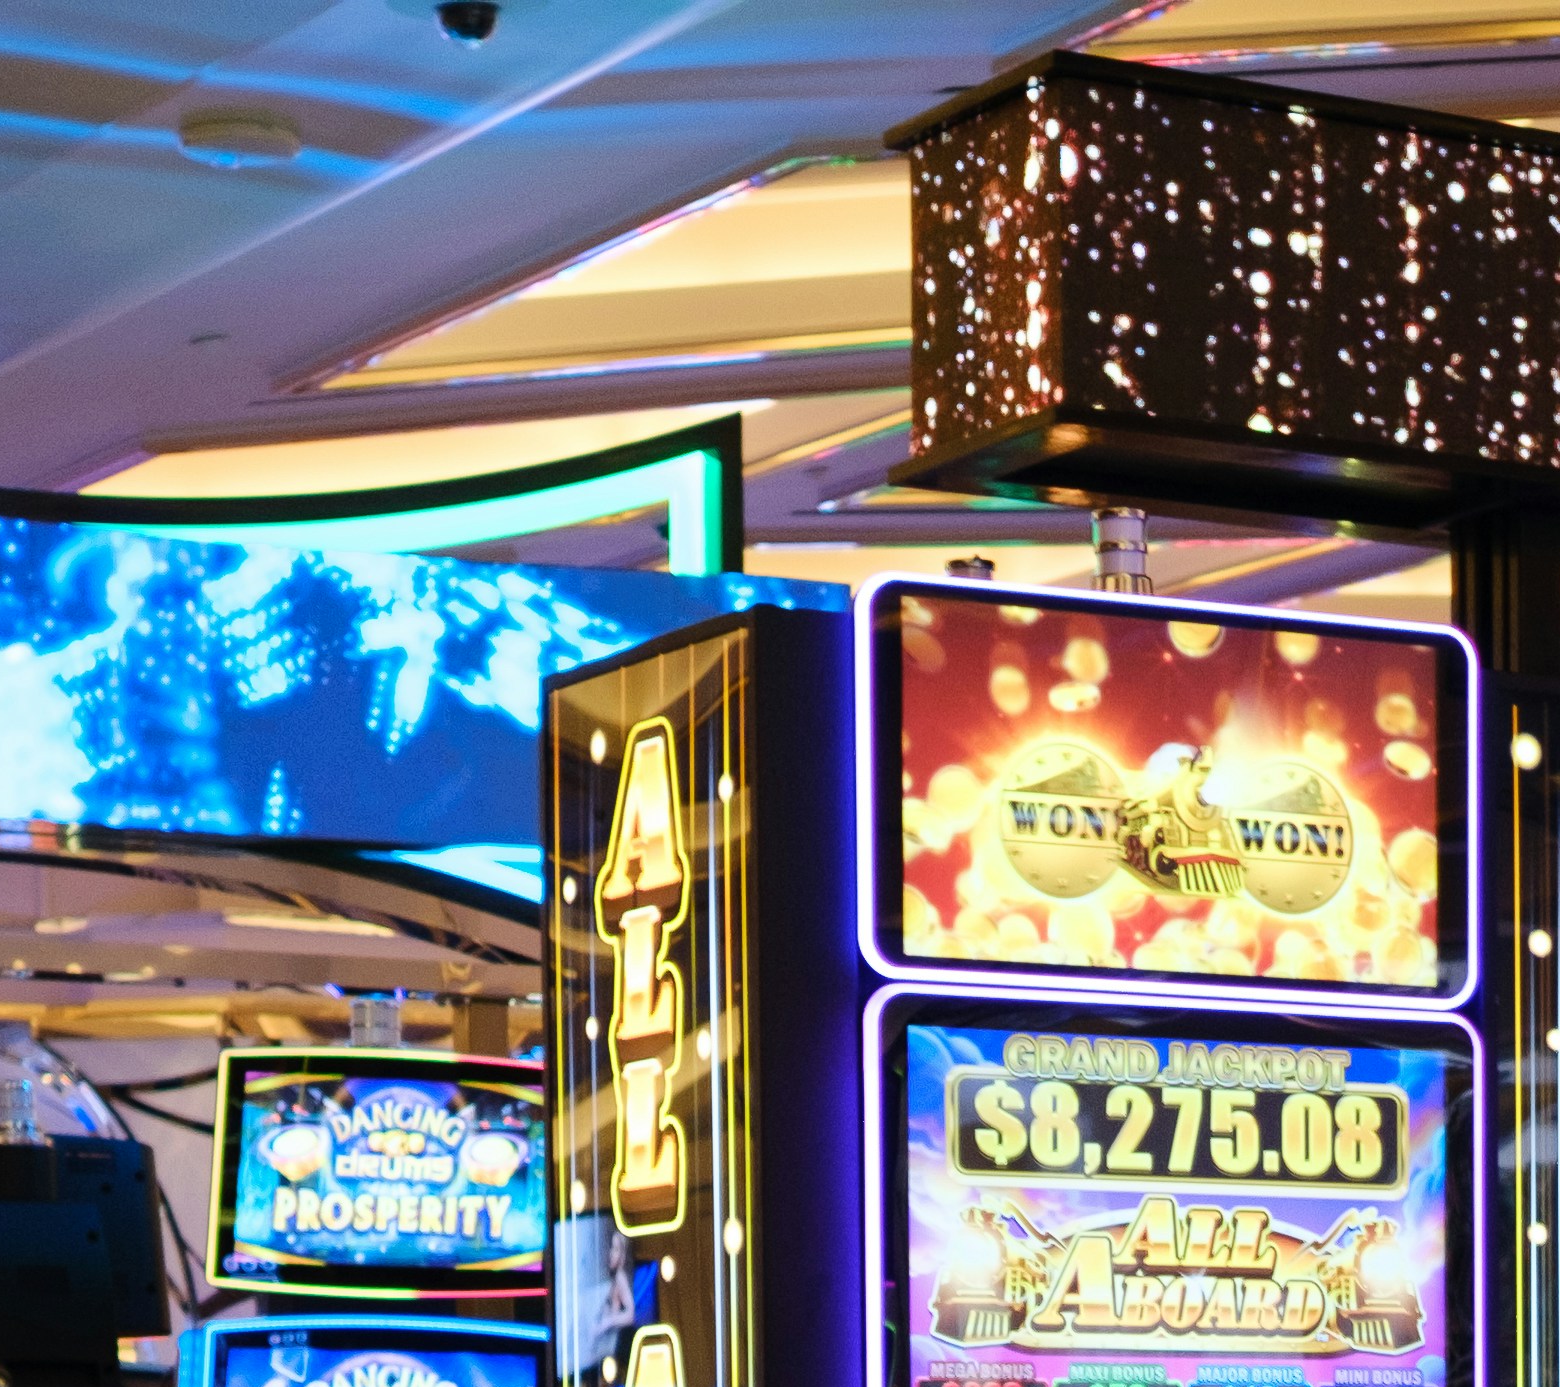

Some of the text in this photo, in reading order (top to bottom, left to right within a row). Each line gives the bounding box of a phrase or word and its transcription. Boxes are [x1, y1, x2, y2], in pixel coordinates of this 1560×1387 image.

[1236, 817, 1346, 858] WON!
[595, 716, 687, 1236] ALL
[1005, 1035, 1351, 1092] GRAND JACKPOT
[330, 1101, 466, 1147] DANCING
[974, 1080, 1382, 1180] $8,275.08
[272, 1186, 511, 1239] PROSPERITY
[1115, 1194, 1278, 1274] ALL
[1032, 1232, 1327, 1337] ABOARD
[930, 1362, 1034, 1380] MEGA BONUS
[1070, 1365, 1166, 1383] MAXI BONUS
[1198, 1367, 1304, 1385] MAJOR BONUS
[1335, 1369, 1422, 1386] MINI BONUS
